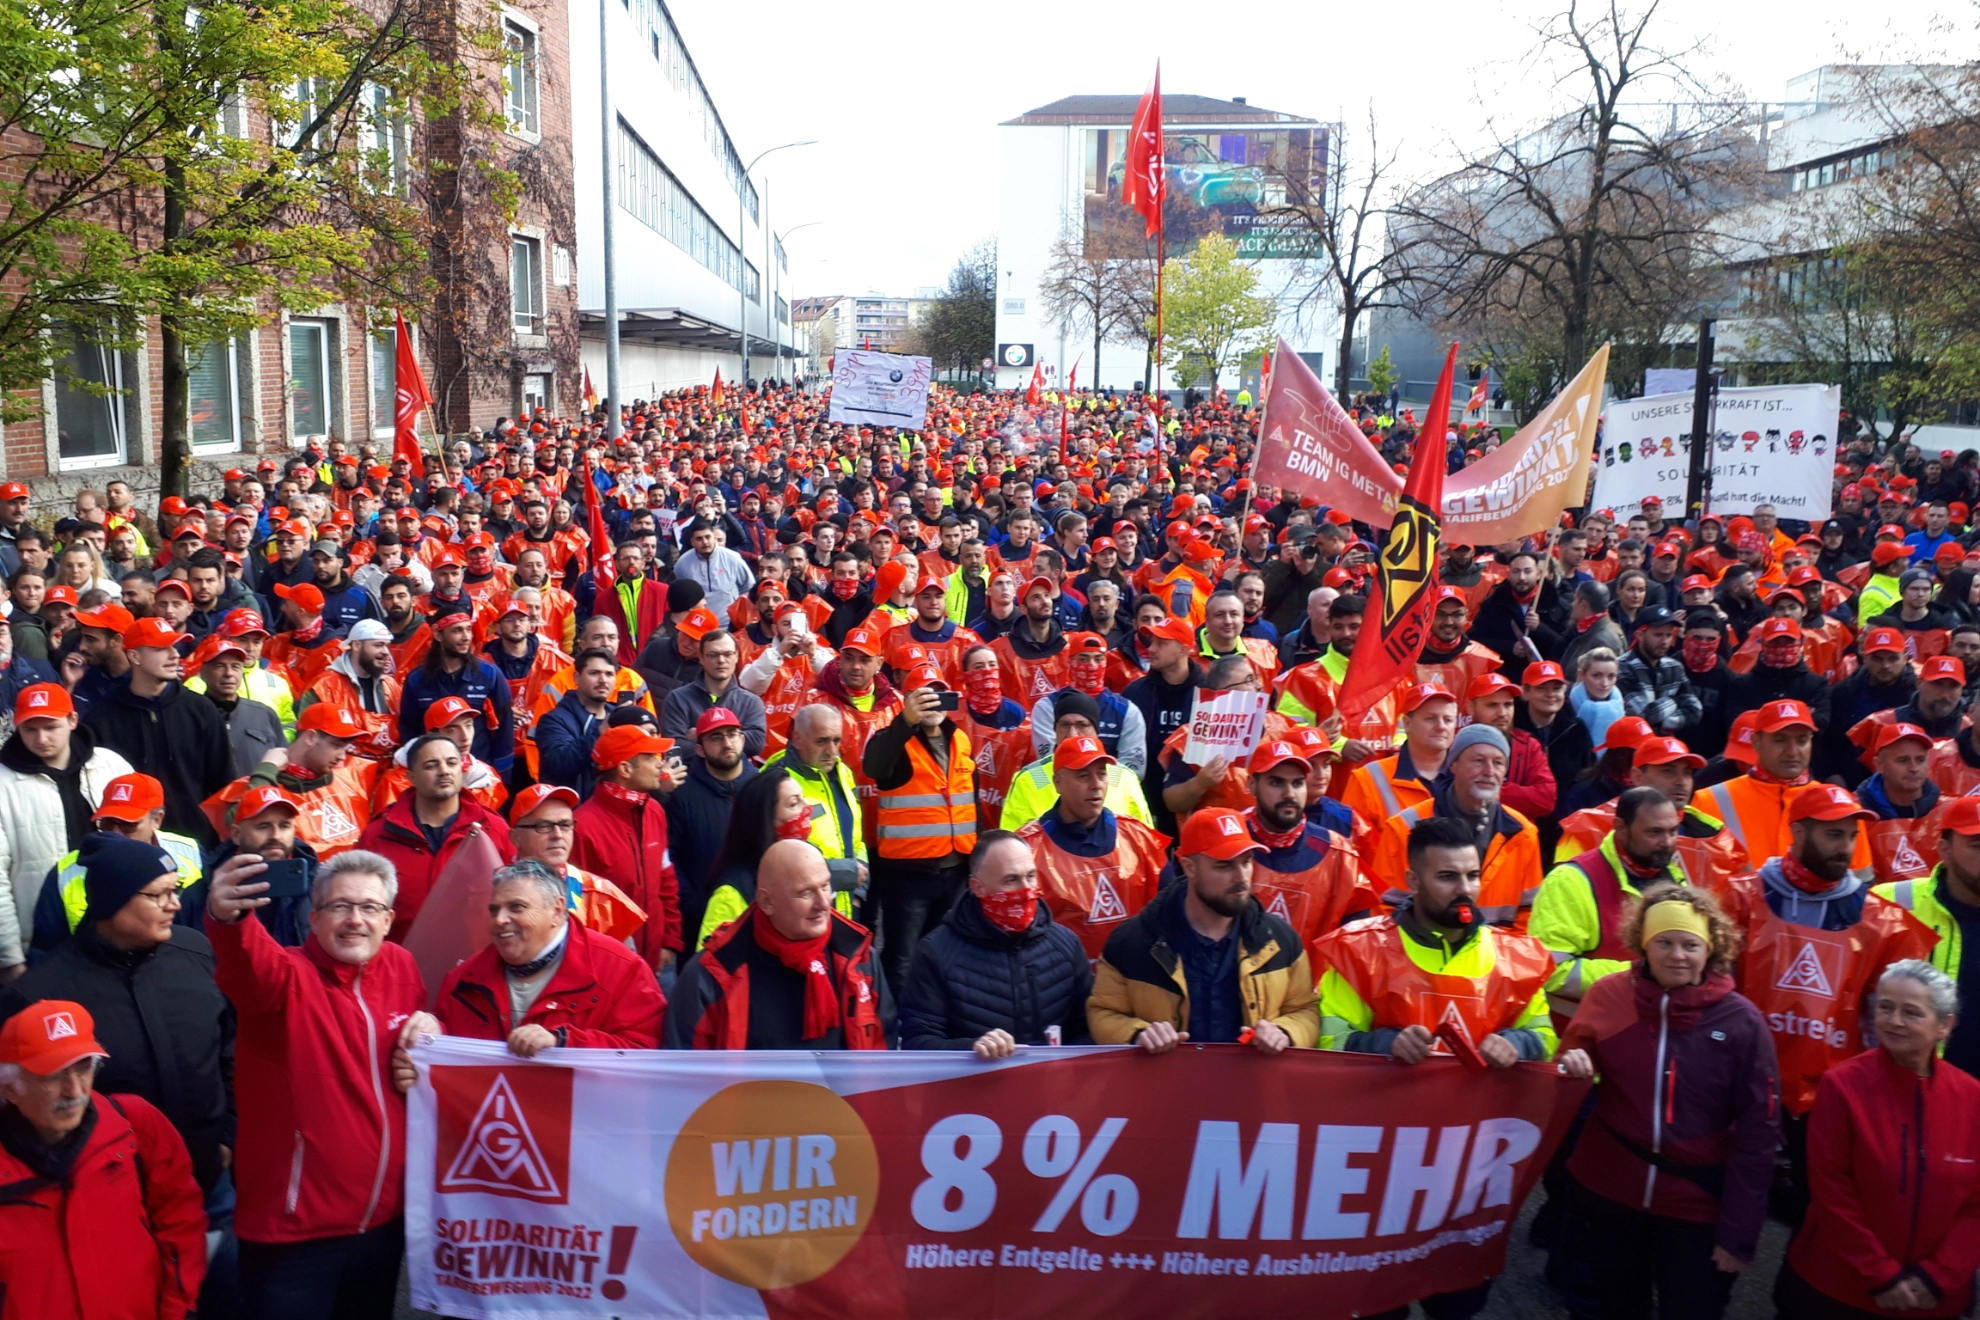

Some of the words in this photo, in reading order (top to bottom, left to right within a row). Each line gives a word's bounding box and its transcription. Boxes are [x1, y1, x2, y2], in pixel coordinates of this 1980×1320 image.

[1631, 404, 1681, 422] UNSERE
[1684, 399, 1762, 414] SRKRAFT
[1286, 450, 1330, 482] BMW
[1293, 428, 1334, 468] TEAM
[1335, 458, 1350, 480] IG
[1441, 431, 1577, 515] GEWINNT
[711, 1133, 837, 1197] WIR
[1176, 1117, 1542, 1241] MEHR
[435, 1217, 603, 1252] SOLIDARITÄT
[691, 1195, 858, 1242] FORDERN
[905, 1244, 994, 1269] Höhere
[1000, 1244, 1104, 1274] Entgelte
[1161, 1251, 1249, 1276] Höhere
